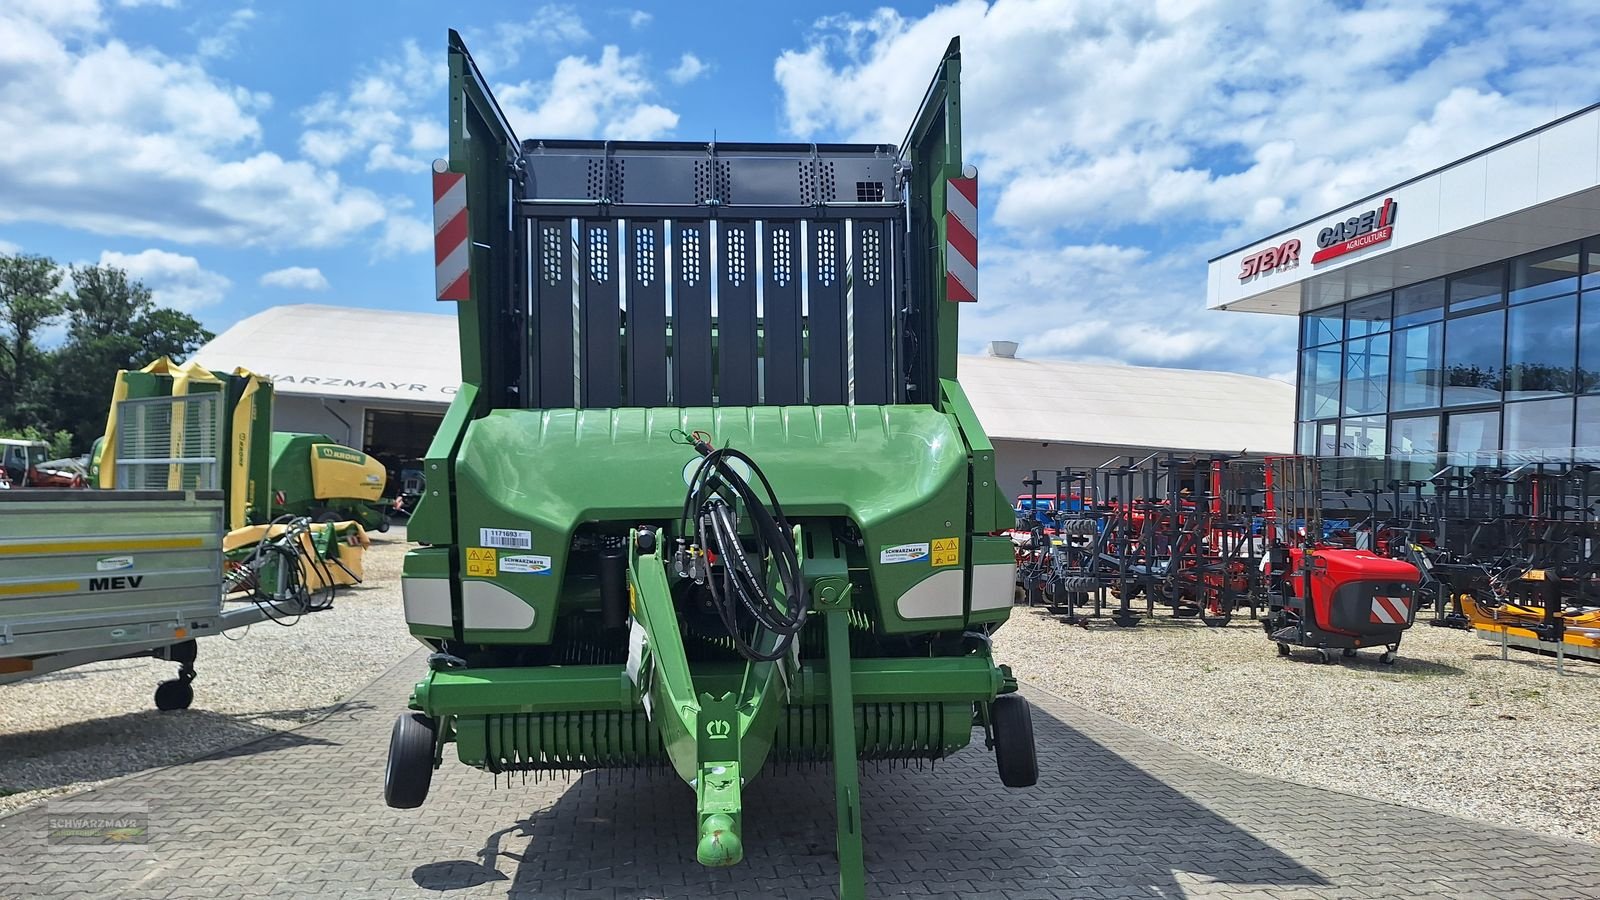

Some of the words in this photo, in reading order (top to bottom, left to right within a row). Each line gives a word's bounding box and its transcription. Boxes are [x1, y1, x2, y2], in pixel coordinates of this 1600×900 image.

[1346, 229, 1388, 251] AGRICULTURE
[1238, 239, 1301, 280] STEYR
[89, 575, 143, 591] MEV
